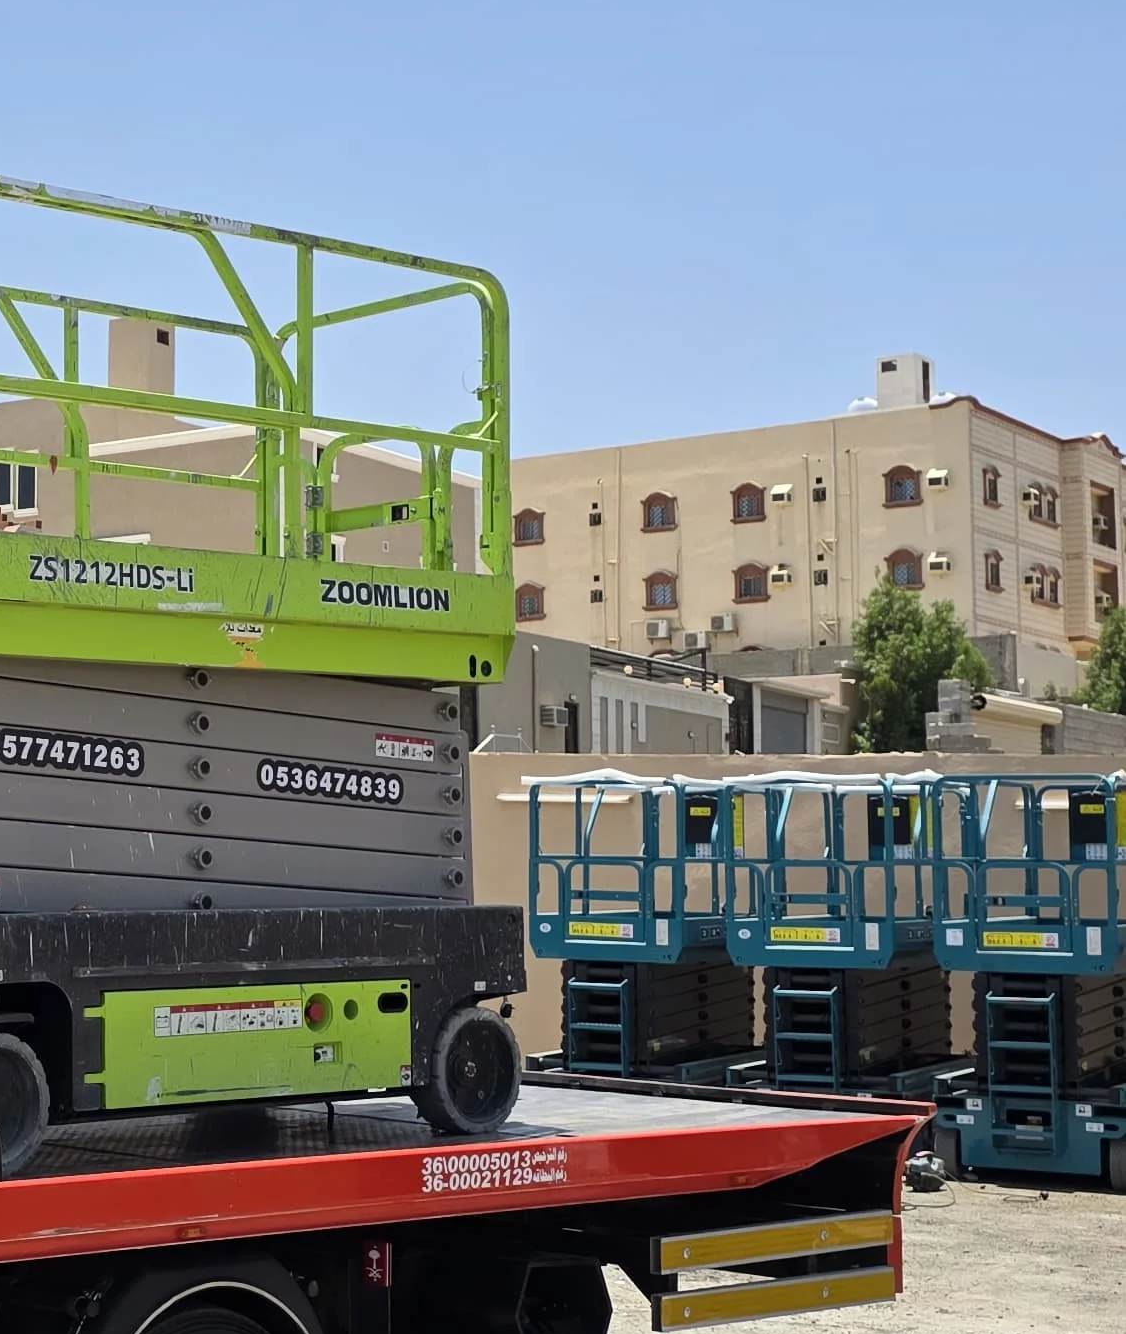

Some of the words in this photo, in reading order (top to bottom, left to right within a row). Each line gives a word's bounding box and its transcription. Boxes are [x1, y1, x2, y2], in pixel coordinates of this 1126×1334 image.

[29, 555, 194, 594] ZS1212HDS-Li
[320, 578, 451, 613] ZOOMLION
[260, 764, 401, 801] 0536474839
[422, 1151, 531, 1175] 36\00005013
[422, 1168, 532, 1193] 36-00021129
